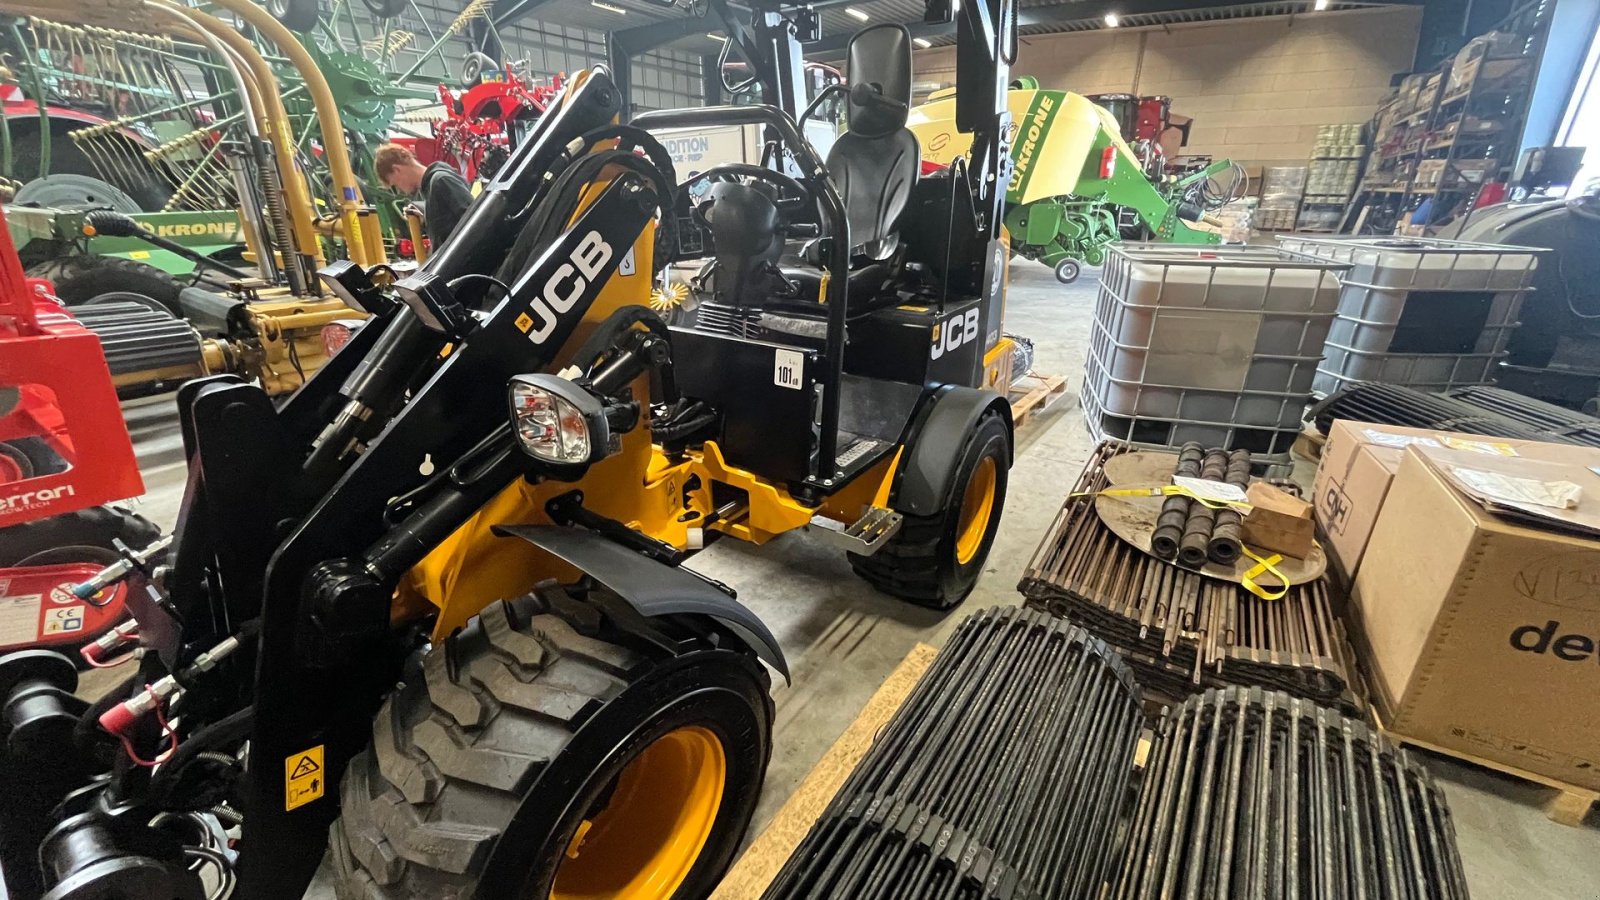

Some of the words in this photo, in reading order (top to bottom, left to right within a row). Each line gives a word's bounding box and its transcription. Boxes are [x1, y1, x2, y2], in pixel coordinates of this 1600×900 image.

[1018, 95, 1054, 172] KRONE
[159, 222, 237, 237] KRONE
[528, 230, 613, 345] JCB
[931, 307, 980, 361] JCB
[778, 365, 792, 385] 101
[1509, 620, 1600, 666] de
